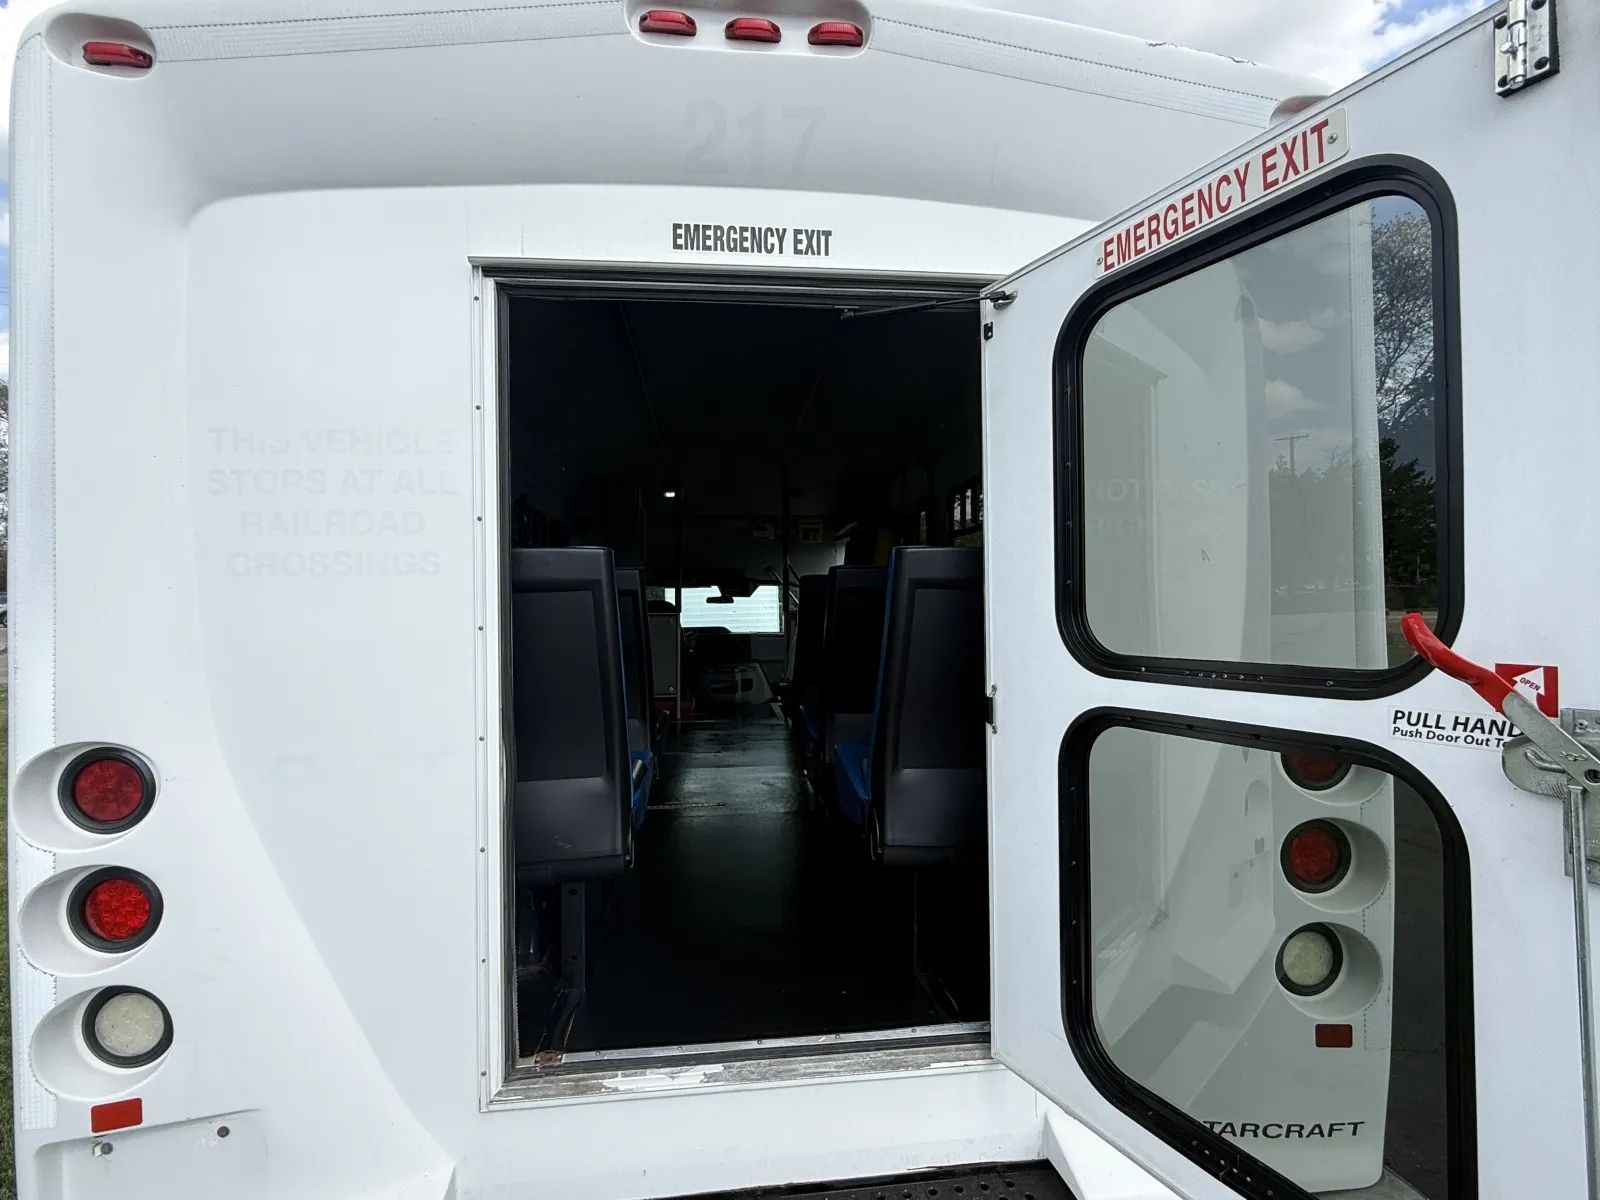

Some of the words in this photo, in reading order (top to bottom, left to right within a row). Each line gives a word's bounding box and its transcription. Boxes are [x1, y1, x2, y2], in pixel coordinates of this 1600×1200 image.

[682, 99, 827, 177] 217
[1103, 161, 1250, 273] EMERGENCY
[1261, 118, 1329, 192] EXIT
[672, 222, 787, 255] EMERGENCY
[793, 228, 832, 257] EXIT
[303, 427, 454, 455] VEHICLE
[207, 469, 327, 496] STOPS
[338, 470, 383, 495] AT
[392, 469, 459, 496] ALL
[240, 509, 427, 536] RAILROAD
[227, 550, 440, 578] CROSSINGS
[1519, 677, 1541, 692] OPEN
[1393, 709, 1446, 730] PULL
[1392, 726, 1423, 740] Push
[1426, 730, 1460, 745] Door
[1464, 735, 1491, 748] Out
[1202, 1120, 1366, 1139] TARCRAFT
